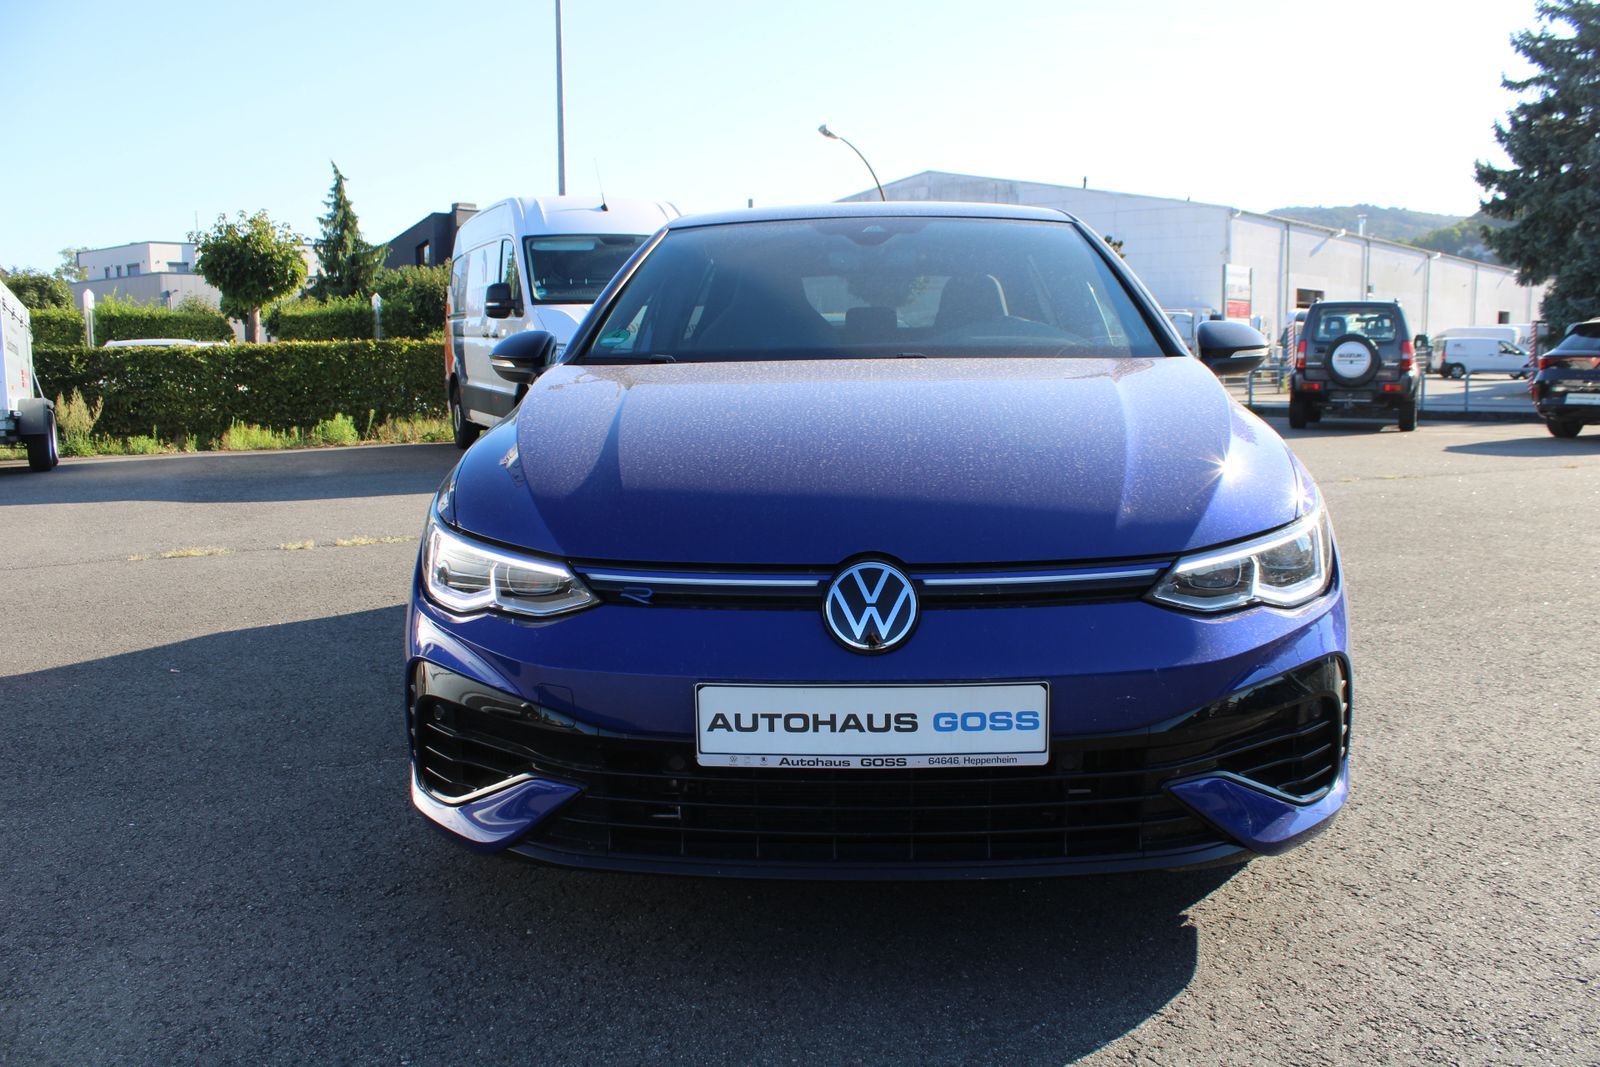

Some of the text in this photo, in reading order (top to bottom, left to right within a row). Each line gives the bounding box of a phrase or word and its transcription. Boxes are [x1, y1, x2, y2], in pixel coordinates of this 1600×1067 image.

[620, 586, 653, 605] R
[834, 567, 910, 641] VW
[706, 711, 1041, 733] AUTOHAUS GOSS
[779, 757, 851, 767] Autohaus
[860, 757, 907, 767] GOSS
[963, 755, 1018, 766] Heppenheim
